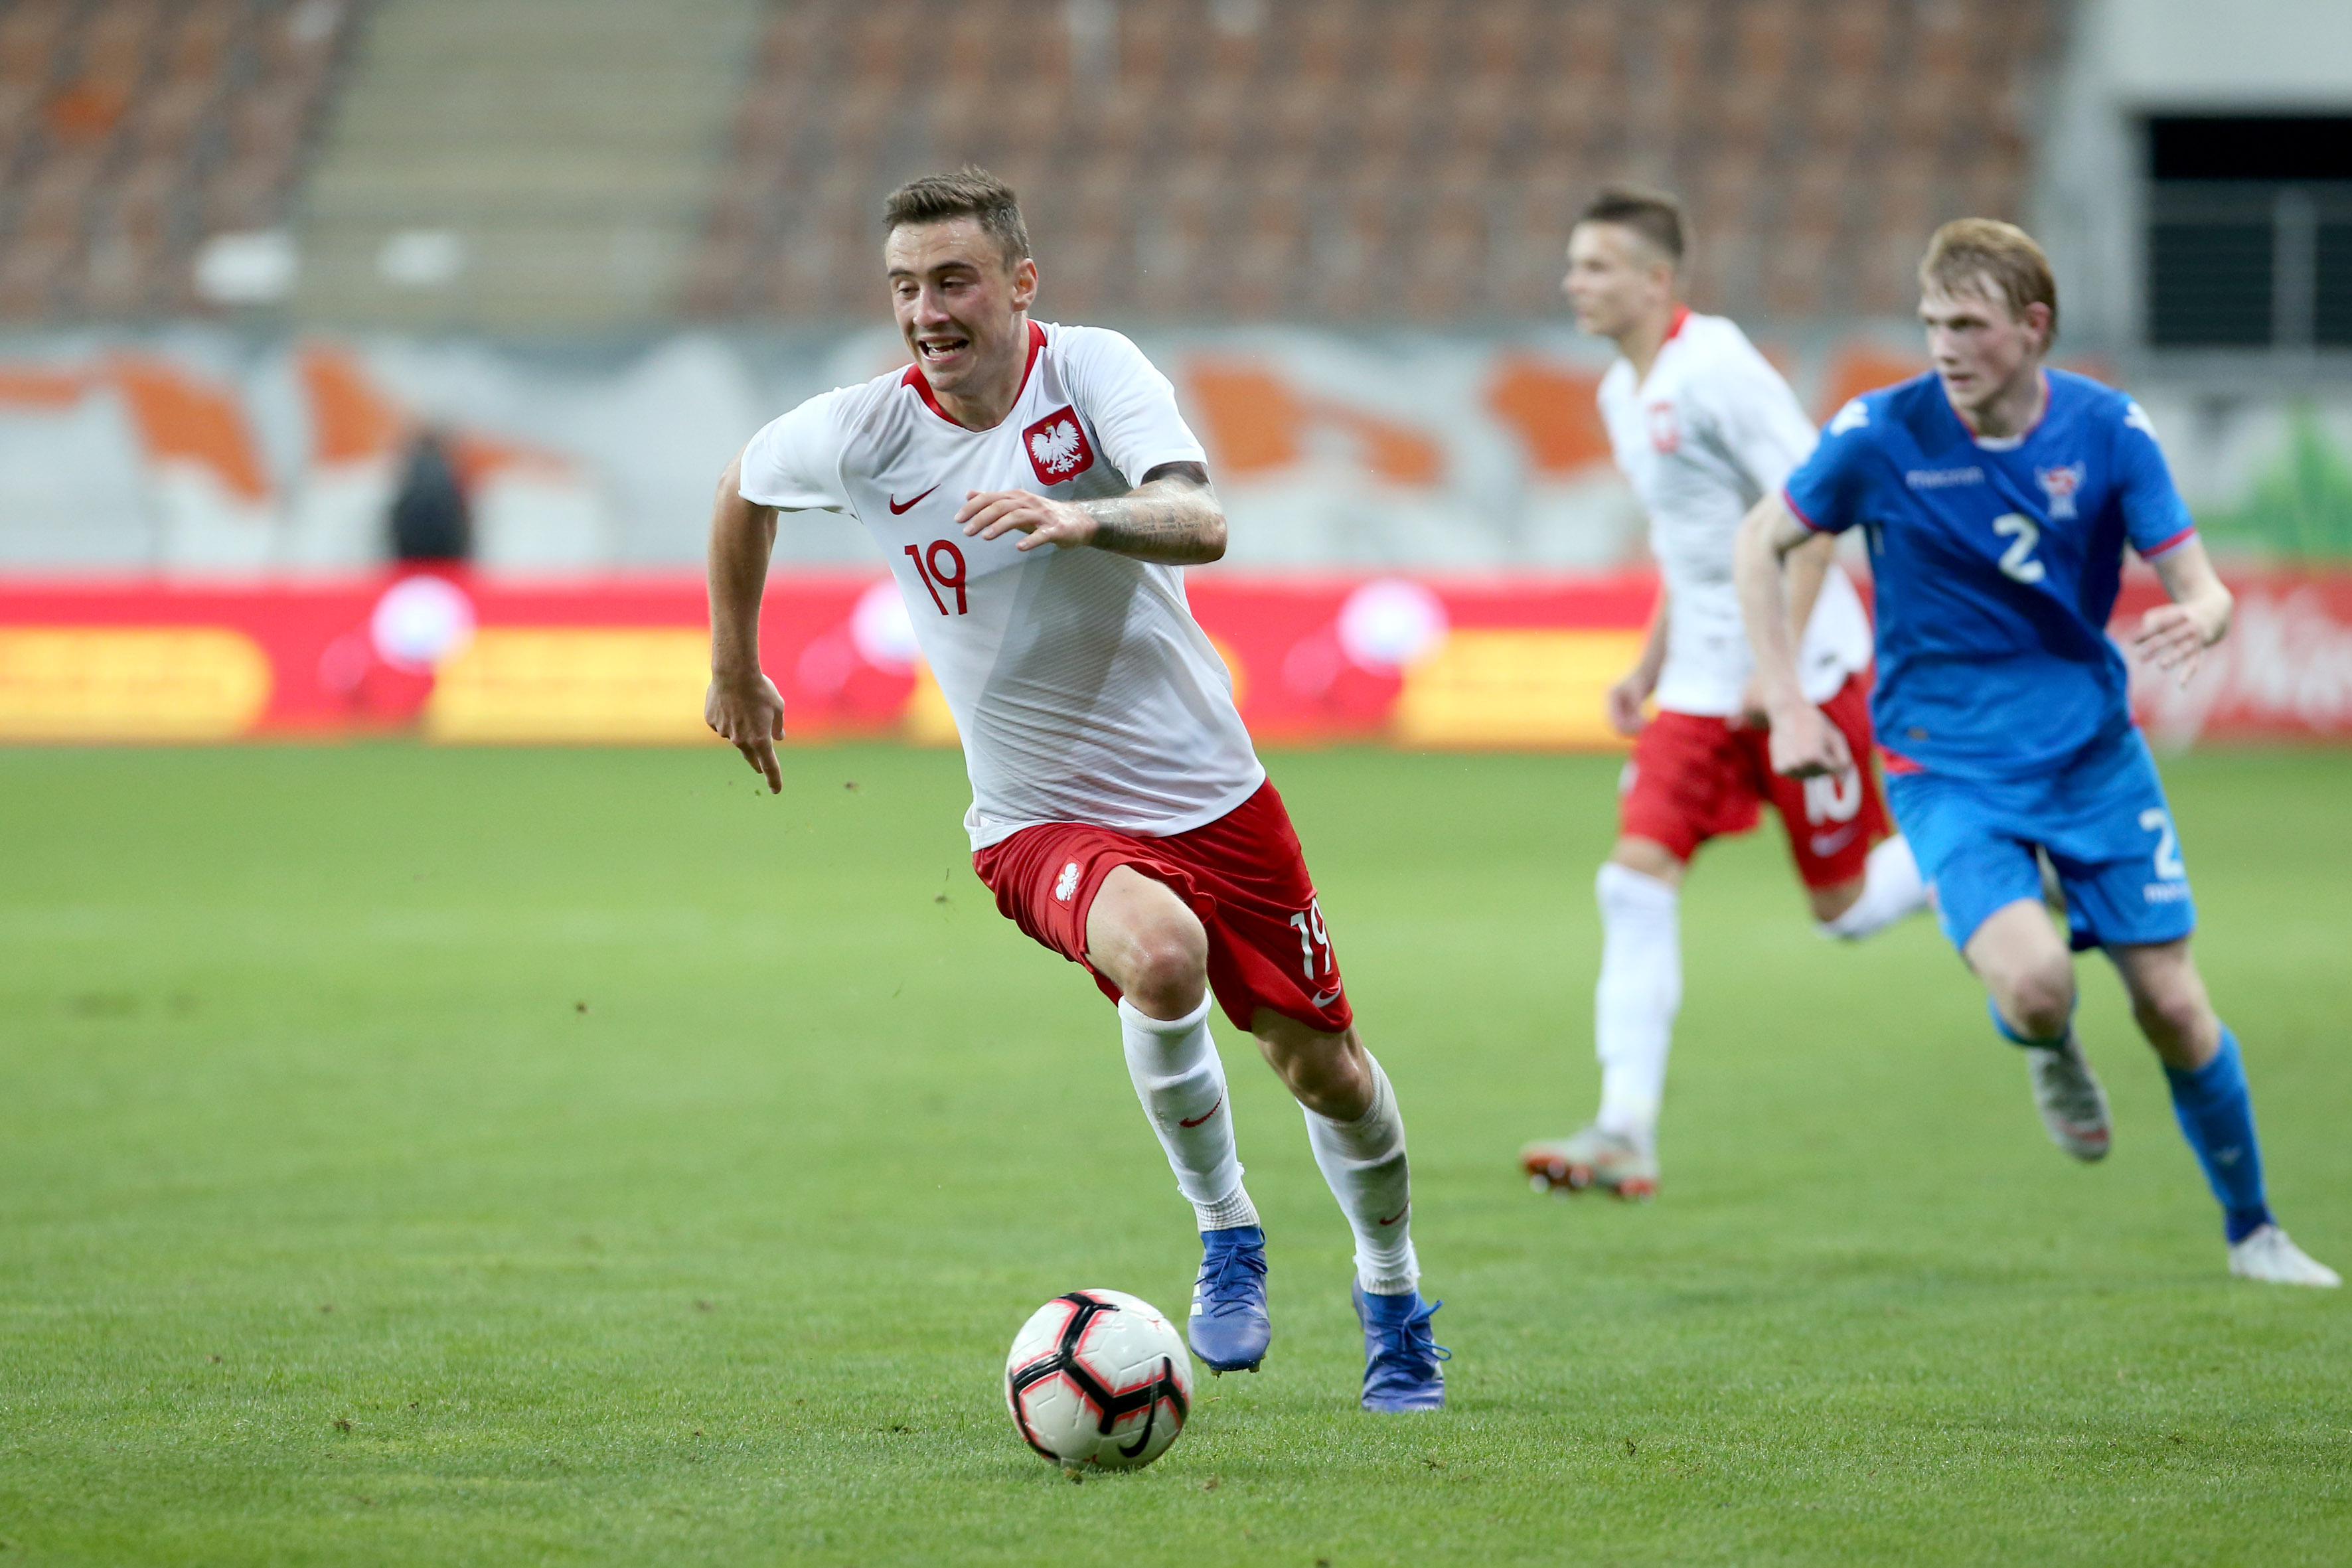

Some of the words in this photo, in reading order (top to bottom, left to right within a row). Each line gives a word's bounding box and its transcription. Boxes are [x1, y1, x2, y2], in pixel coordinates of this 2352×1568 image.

[905, 539, 967, 615] 19
[1992, 513, 2046, 583] 2
[2138, 807, 2185, 881] 2
[1291, 896, 1331, 980] 19
